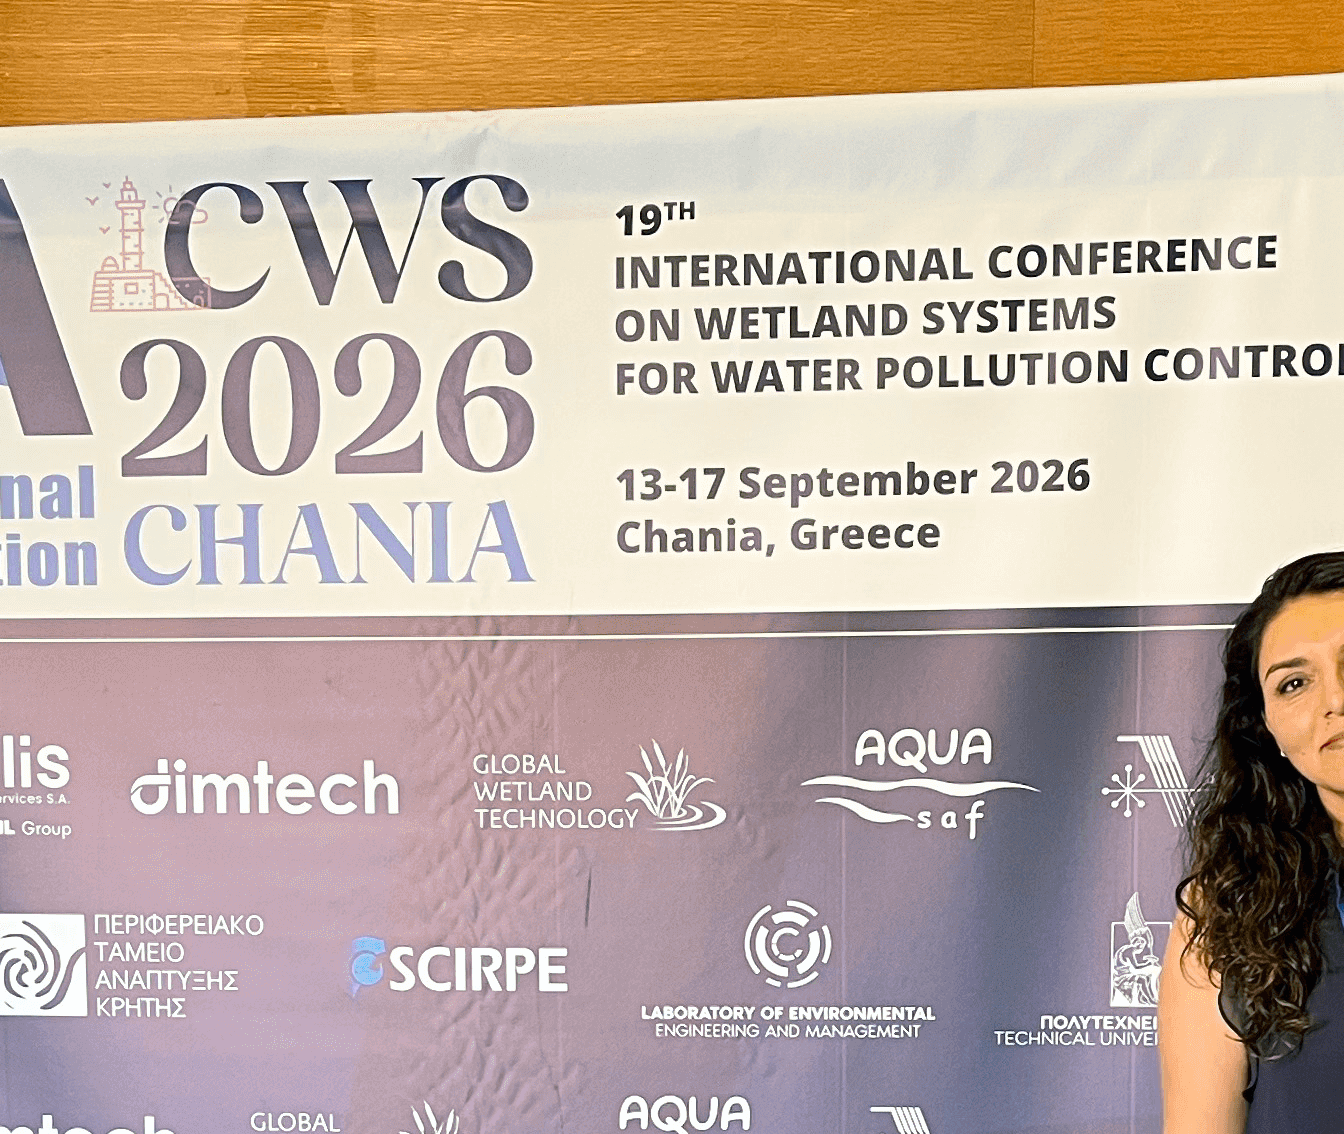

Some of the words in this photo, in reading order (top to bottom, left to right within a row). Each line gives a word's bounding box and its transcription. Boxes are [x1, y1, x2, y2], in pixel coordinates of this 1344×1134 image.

[616, 202, 694, 235] 19TH
[164, 175, 533, 309] CWS
[616, 248, 973, 289] INTERNATIONAL
[989, 235, 1277, 278] CONFERENCE
[616, 309, 679, 342] ON
[694, 304, 907, 340] WETLAND
[923, 296, 1115, 334] SYSTEMS
[617, 362, 698, 395] FOR
[711, 359, 862, 393] WATER
[877, 350, 1127, 389] POLLUTION
[120, 330, 534, 477] 2026
[617, 468, 725, 500] 13-17
[739, 462, 977, 508] September
[991, 459, 1090, 493] 2026
[124, 500, 536, 585] CHANIA
[617, 518, 775, 557] Chania,
[791, 519, 940, 550] Greece
[855, 729, 991, 773] AQUA
[473, 754, 566, 774] GLOBAL
[131, 759, 399, 814] dimtech
[474, 782, 591, 801] WETLAND
[47, 794, 67, 804] S.A.
[474, 809, 638, 828] TECHNOLOGY
[918, 801, 984, 839] saf
[22, 821, 71, 839] Group
[95, 914, 263, 935] ΠΕΡΙΦΕΡΕΙΑΚΟ
[94, 942, 184, 962] ΤΑΜΕΙΟ
[390, 947, 567, 991] SCIRPE
[95, 970, 238, 990] ΑΝΑΠΤΥΞΗΣ
[97, 997, 186, 1017] ΚΡΗΤΗΣ
[642, 1006, 755, 1020] LABORATORY
[761, 1006, 783, 1020] OF
[789, 1007, 935, 1020] ENVIRONMENTAL
[656, 1023, 759, 1037] ENGINEERING
[765, 1024, 799, 1037] AND
[805, 1025, 921, 1038] MANAGEMENT
[1041, 1015, 1157, 1030] ΠΟΛΥΤΕΧΝΕΙ
[994, 1031, 1096, 1046] TECHNICAL
[1100, 1032, 1157, 1046] UNIVE
[251, 1113, 340, 1132] GLOBAL
